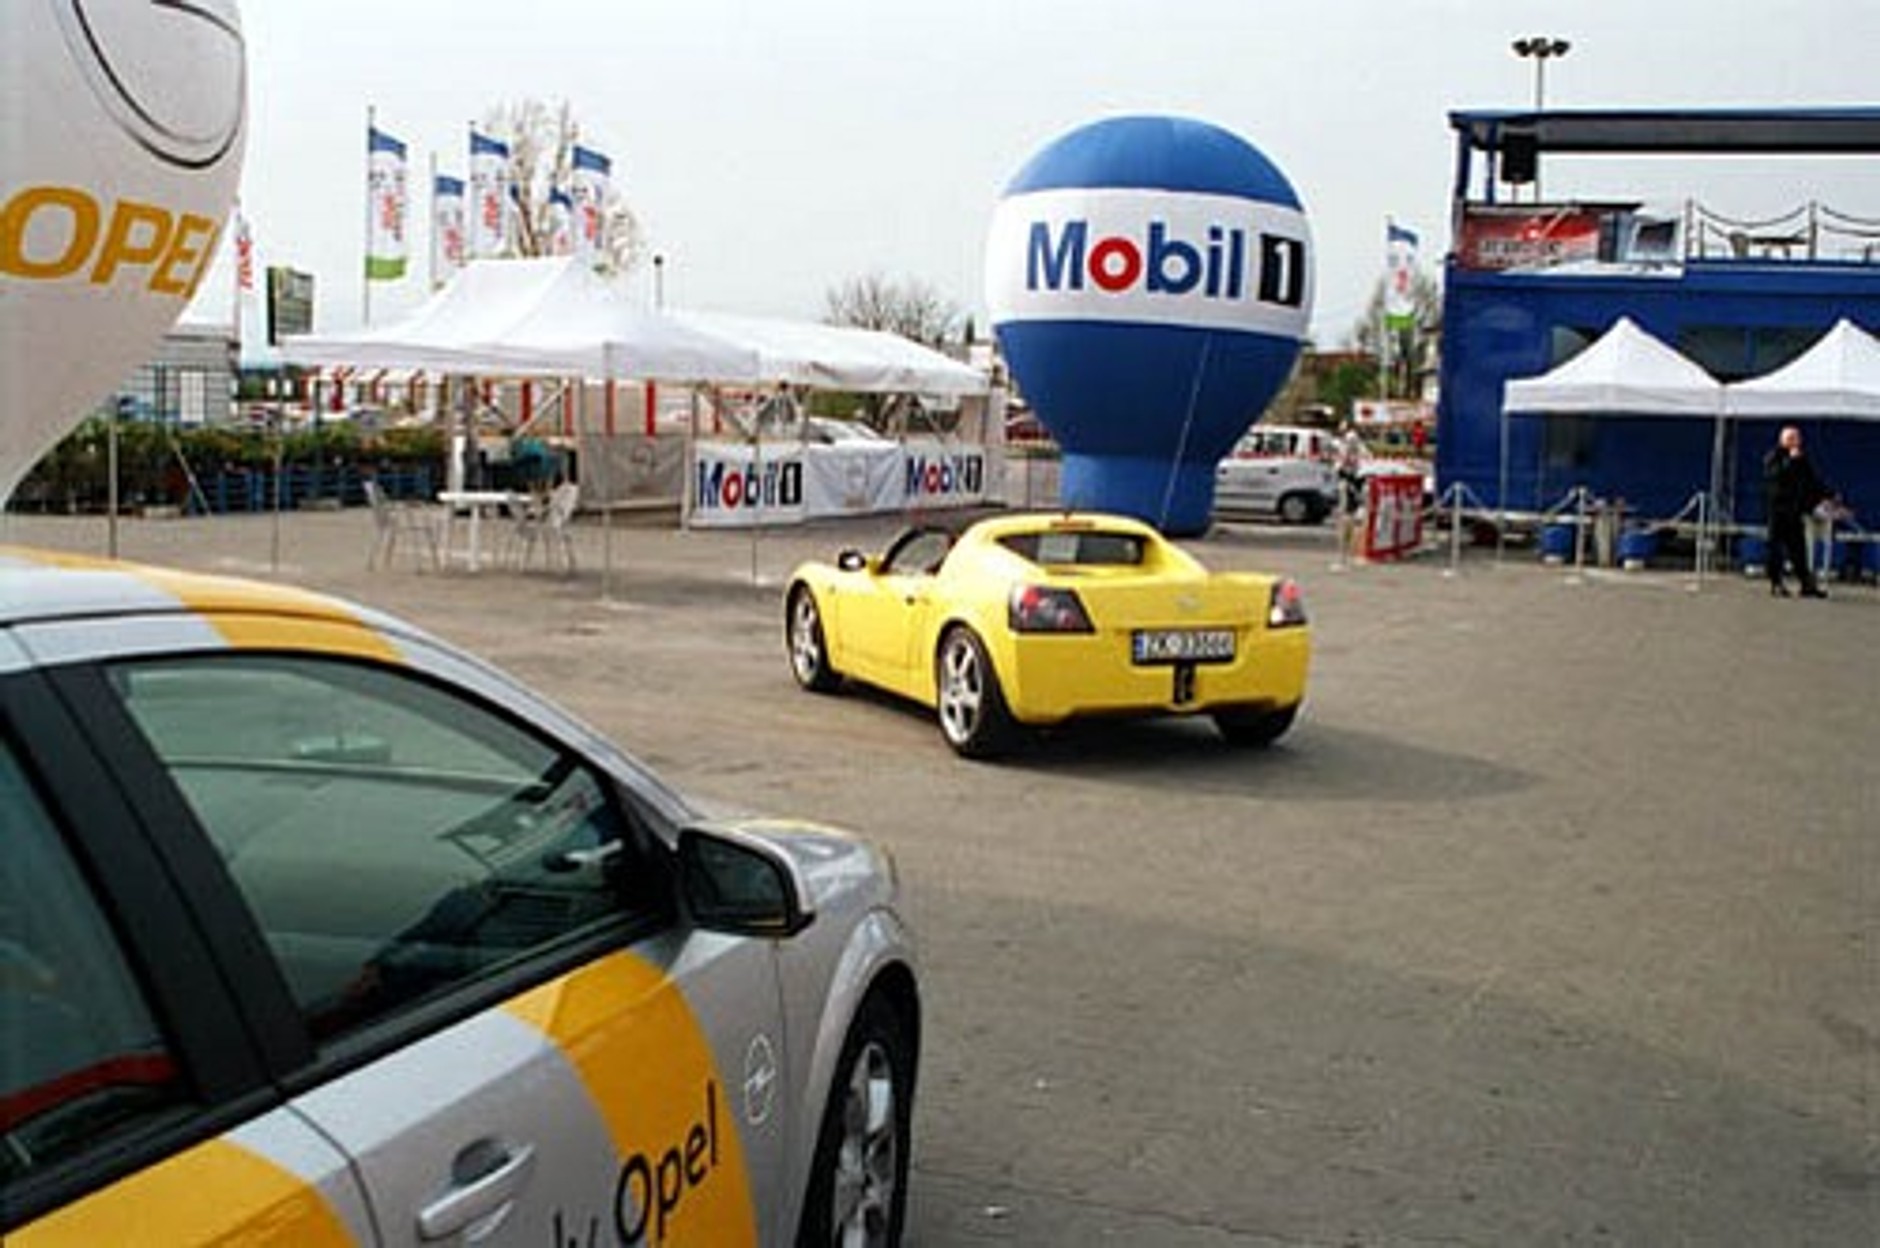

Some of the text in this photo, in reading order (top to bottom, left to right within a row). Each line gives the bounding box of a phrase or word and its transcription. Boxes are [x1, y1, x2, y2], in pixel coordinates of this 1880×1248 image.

[1026, 219, 1245, 299] Mobil
[698, 460, 778, 508] Mobil
[905, 454, 963, 496] Mobil
[614, 1079, 717, 1245] Opel
